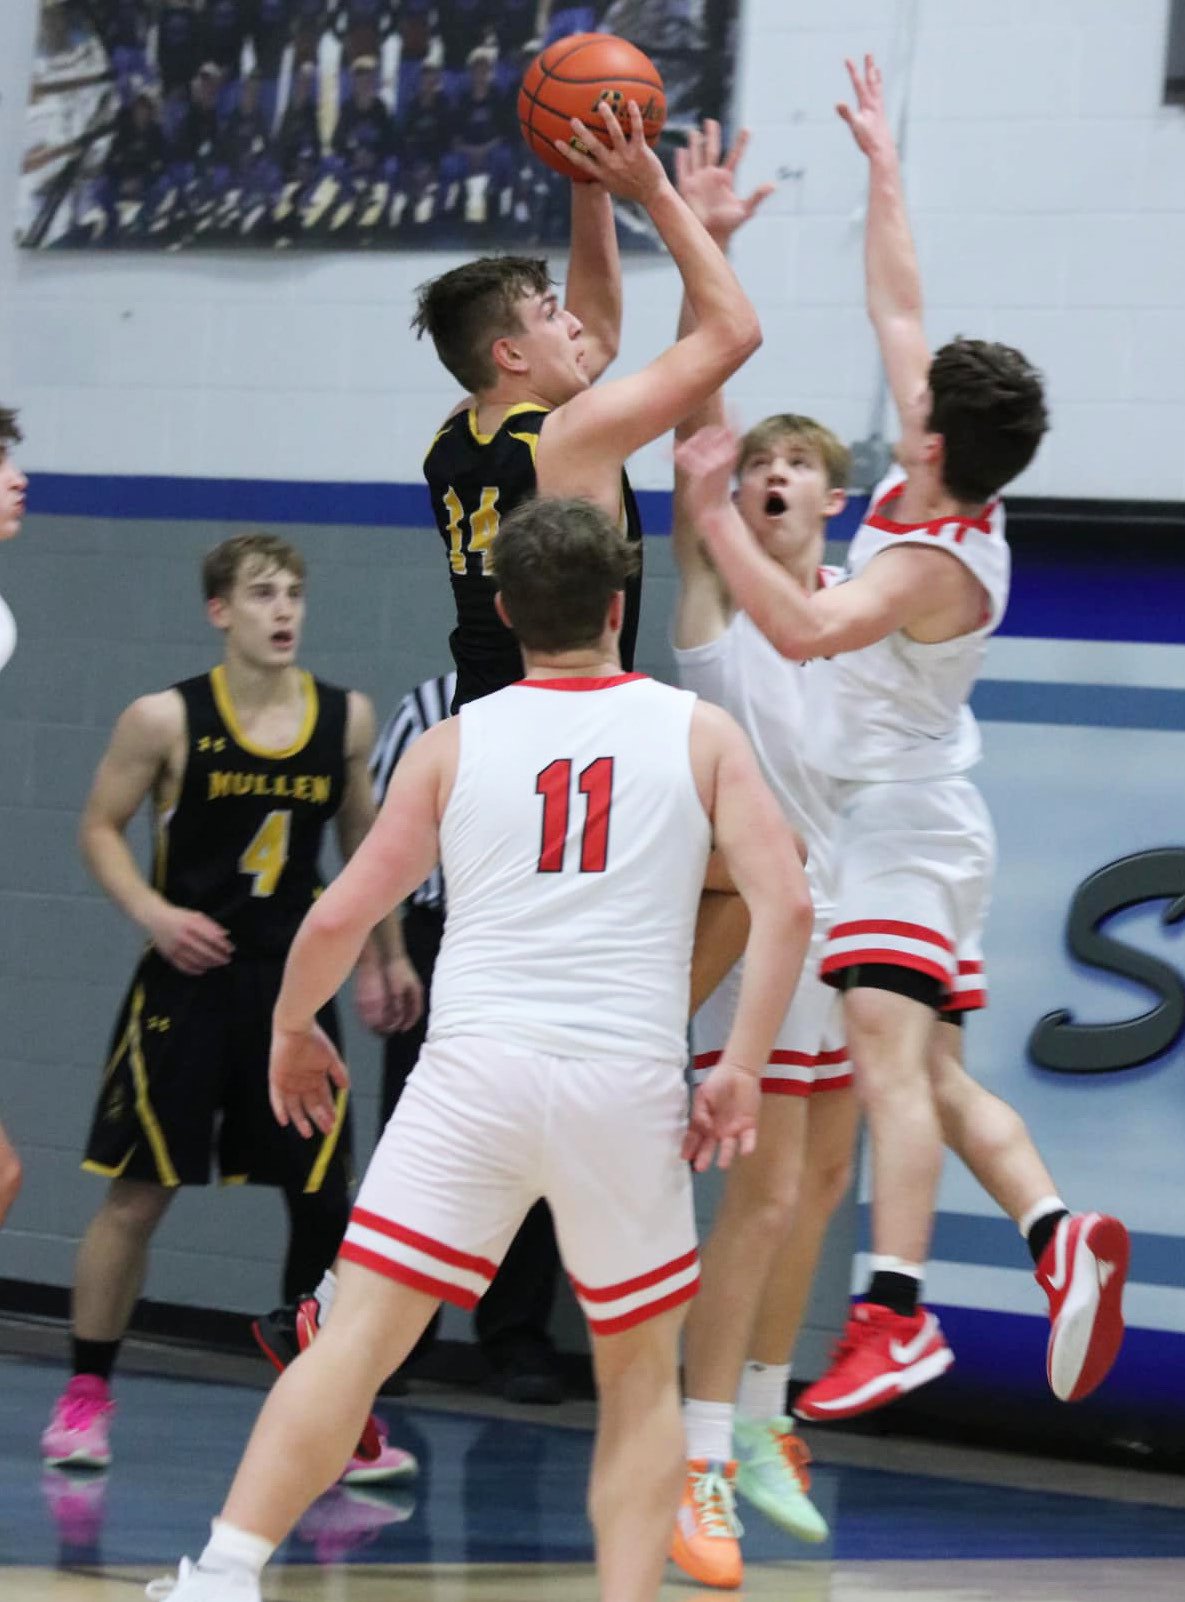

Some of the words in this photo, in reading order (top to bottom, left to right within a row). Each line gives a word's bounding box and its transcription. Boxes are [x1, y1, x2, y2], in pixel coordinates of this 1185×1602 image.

[443, 485, 500, 576] 14
[207, 770, 331, 805] MULLEN
[535, 756, 615, 873] 11
[237, 809, 293, 898] 4
